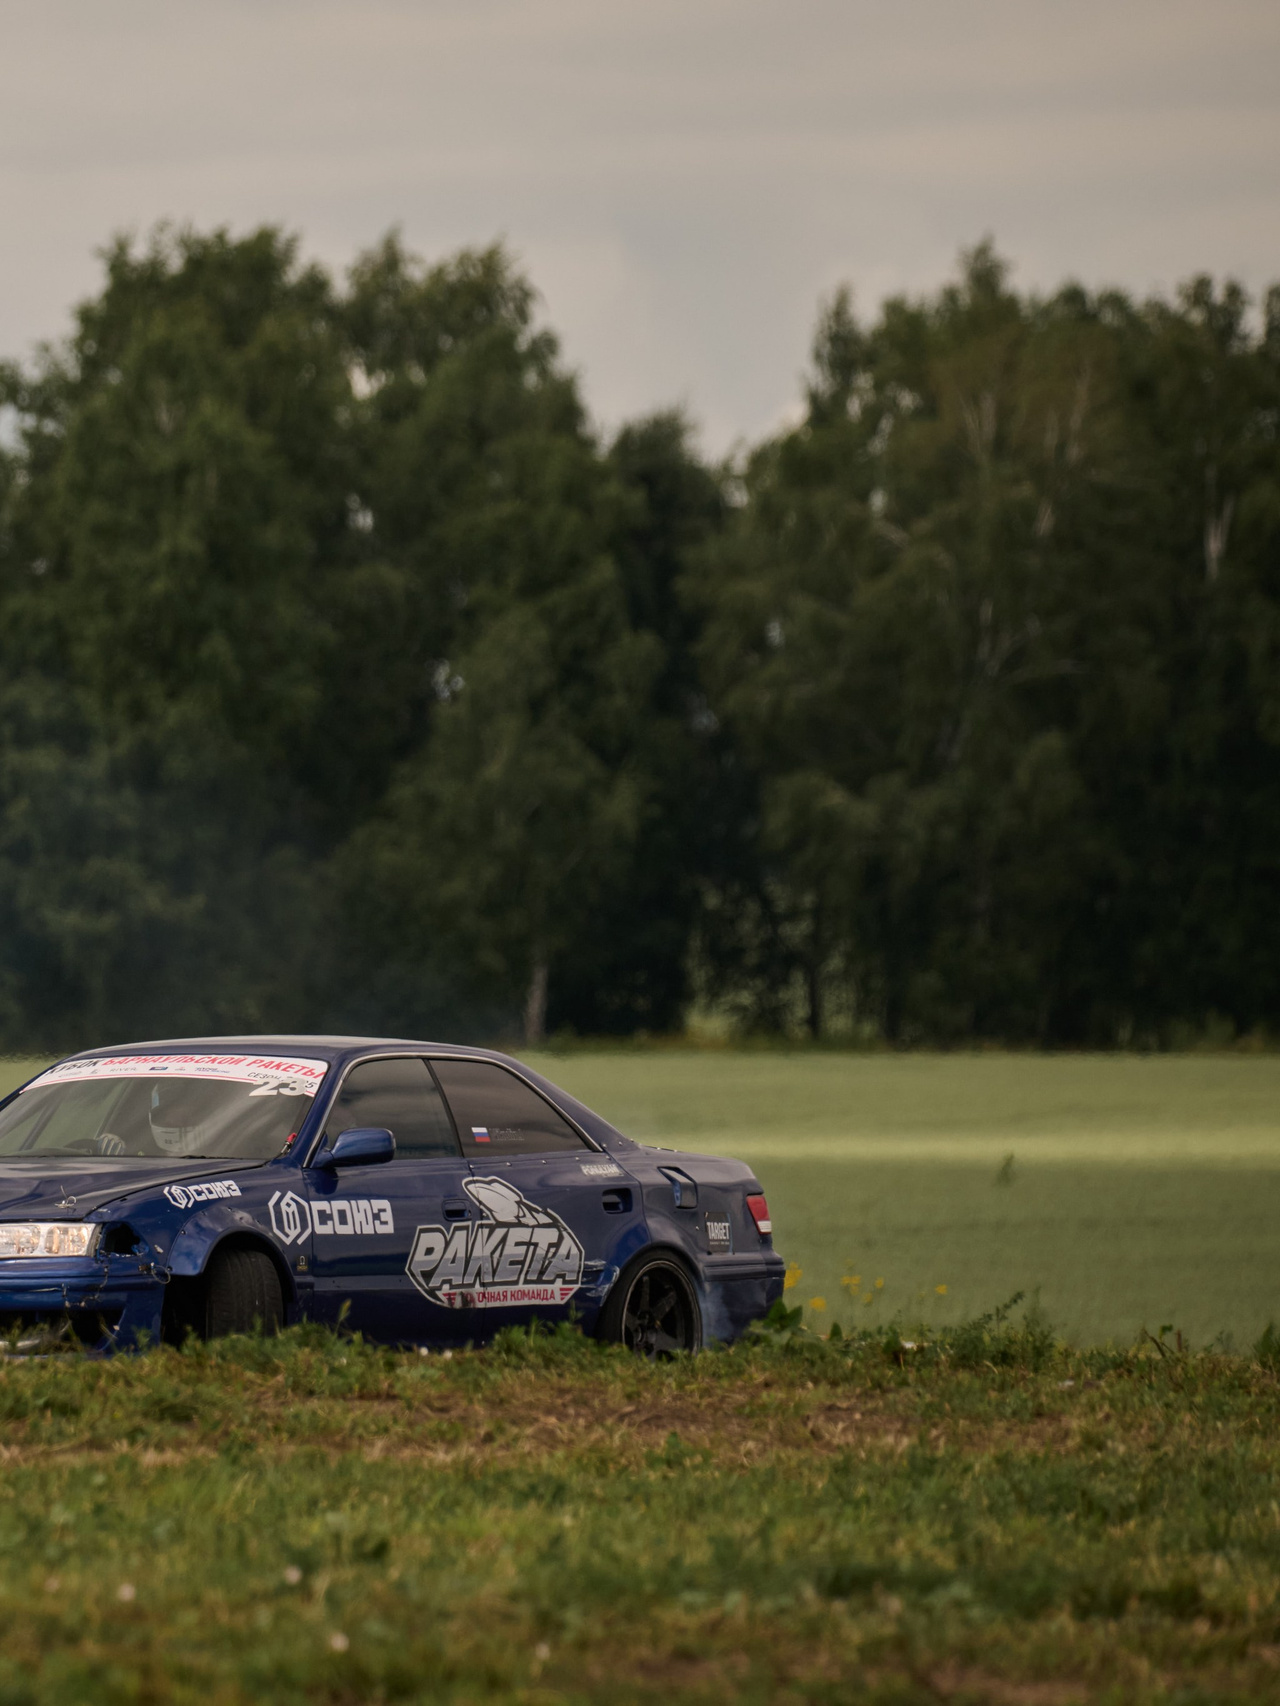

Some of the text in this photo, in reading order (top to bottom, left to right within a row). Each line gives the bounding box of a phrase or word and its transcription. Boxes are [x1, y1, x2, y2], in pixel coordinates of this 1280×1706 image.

[102, 1056, 248, 1066] БАРНАУЛЬСКОЙ
[246, 1059, 326, 1079] РАКЕТЫ
[248, 1077, 308, 1096] 23
[192, 1180, 242, 1201] СОЮЗ
[311, 1199, 395, 1234] СОЮЗ
[706, 1221, 730, 1239] TARGET
[412, 1226, 582, 1288] РАКЕТА
[510, 1288, 556, 1302] КОМАНДА
